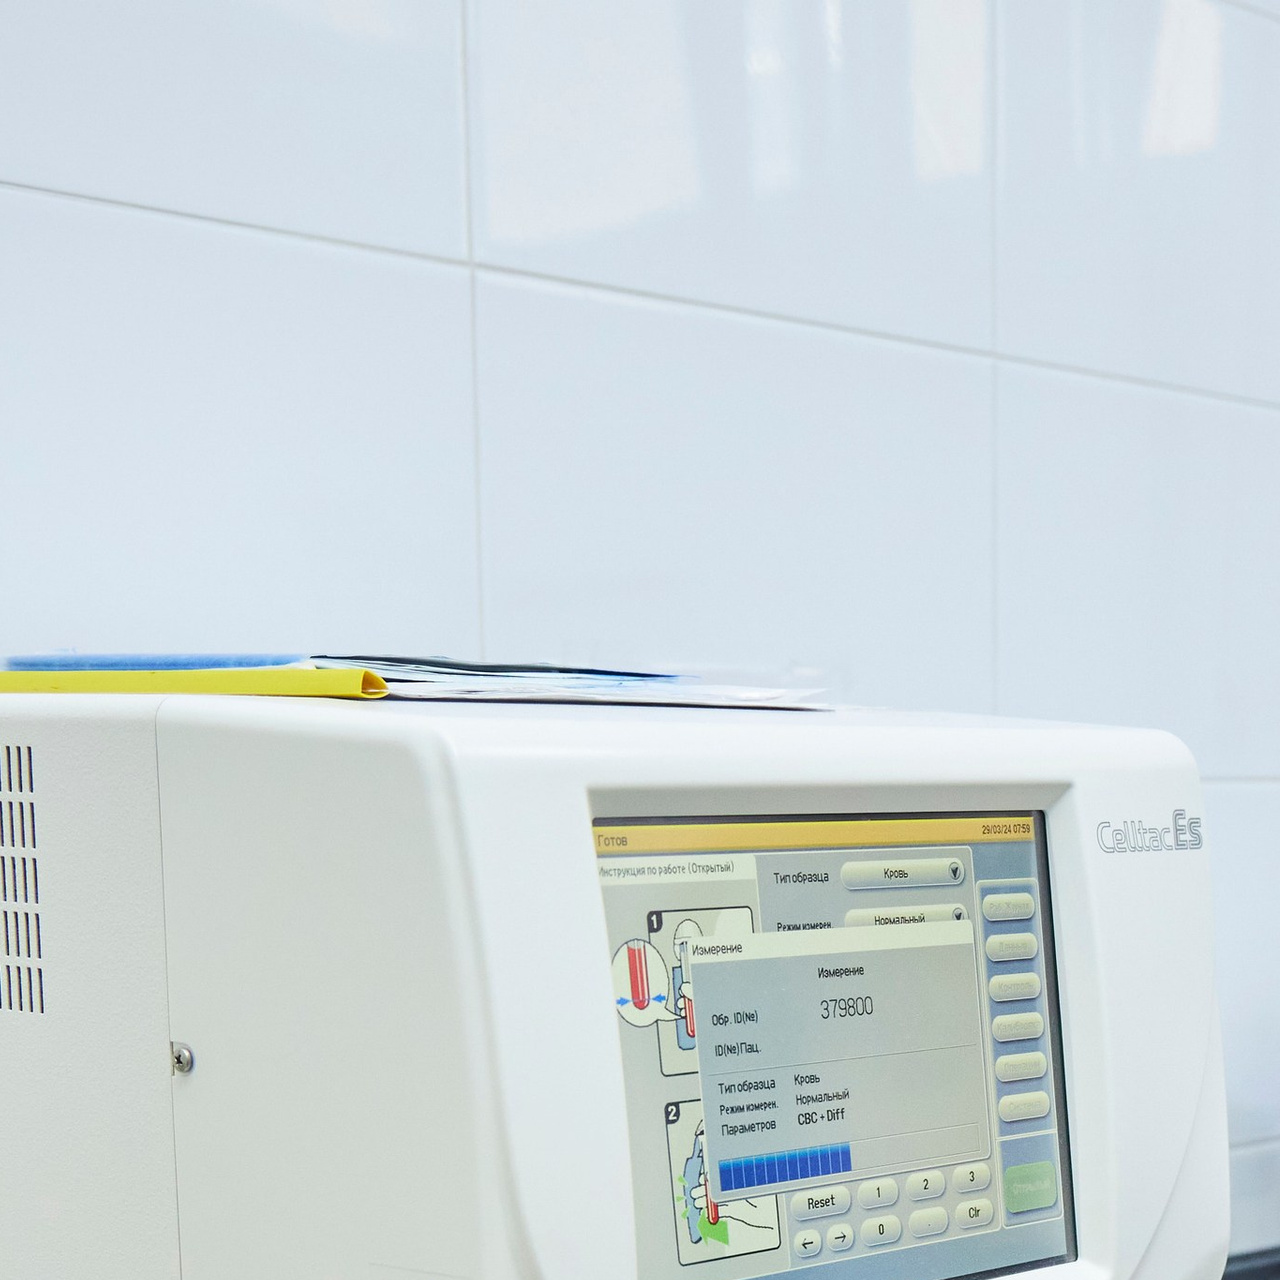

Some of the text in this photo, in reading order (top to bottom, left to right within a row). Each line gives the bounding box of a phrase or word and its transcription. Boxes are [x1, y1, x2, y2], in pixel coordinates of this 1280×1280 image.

[981, 824, 1012, 835] 29/03/24
[597, 834, 628, 847] Готов
[647, 867, 656, 876] по
[658, 864, 686, 876] работе
[688, 861, 735, 875] (Открытый)
[883, 868, 909, 880] Кровь
[774, 871, 829, 884] Тип образца
[650, 914, 658, 929] 1
[874, 912, 926, 925] Нормальный
[777, 922, 801, 932] Режим
[692, 943, 742, 956] Измерение
[817, 966, 864, 979] Измерение
[820, 996, 874, 1020] 379800
[712, 1013, 732, 1026] Обр.
[718, 1079, 776, 1095] Тип образца
[794, 1074, 821, 1087] Кровь
[795, 1088, 850, 1106] Нормальный
[667, 1105, 677, 1120] 2
[719, 1100, 779, 1116] Режим измерен.
[797, 1111, 818, 1126] CBC
[827, 1108, 846, 1123] Diff
[721, 1120, 776, 1136] Параметров
[968, 1171, 975, 1182] 3
[923, 1178, 929, 1190] 2
[808, 1195, 835, 1210] Reset
[968, 1207, 981, 1219] Clr
[878, 1224, 885, 1235] 0
